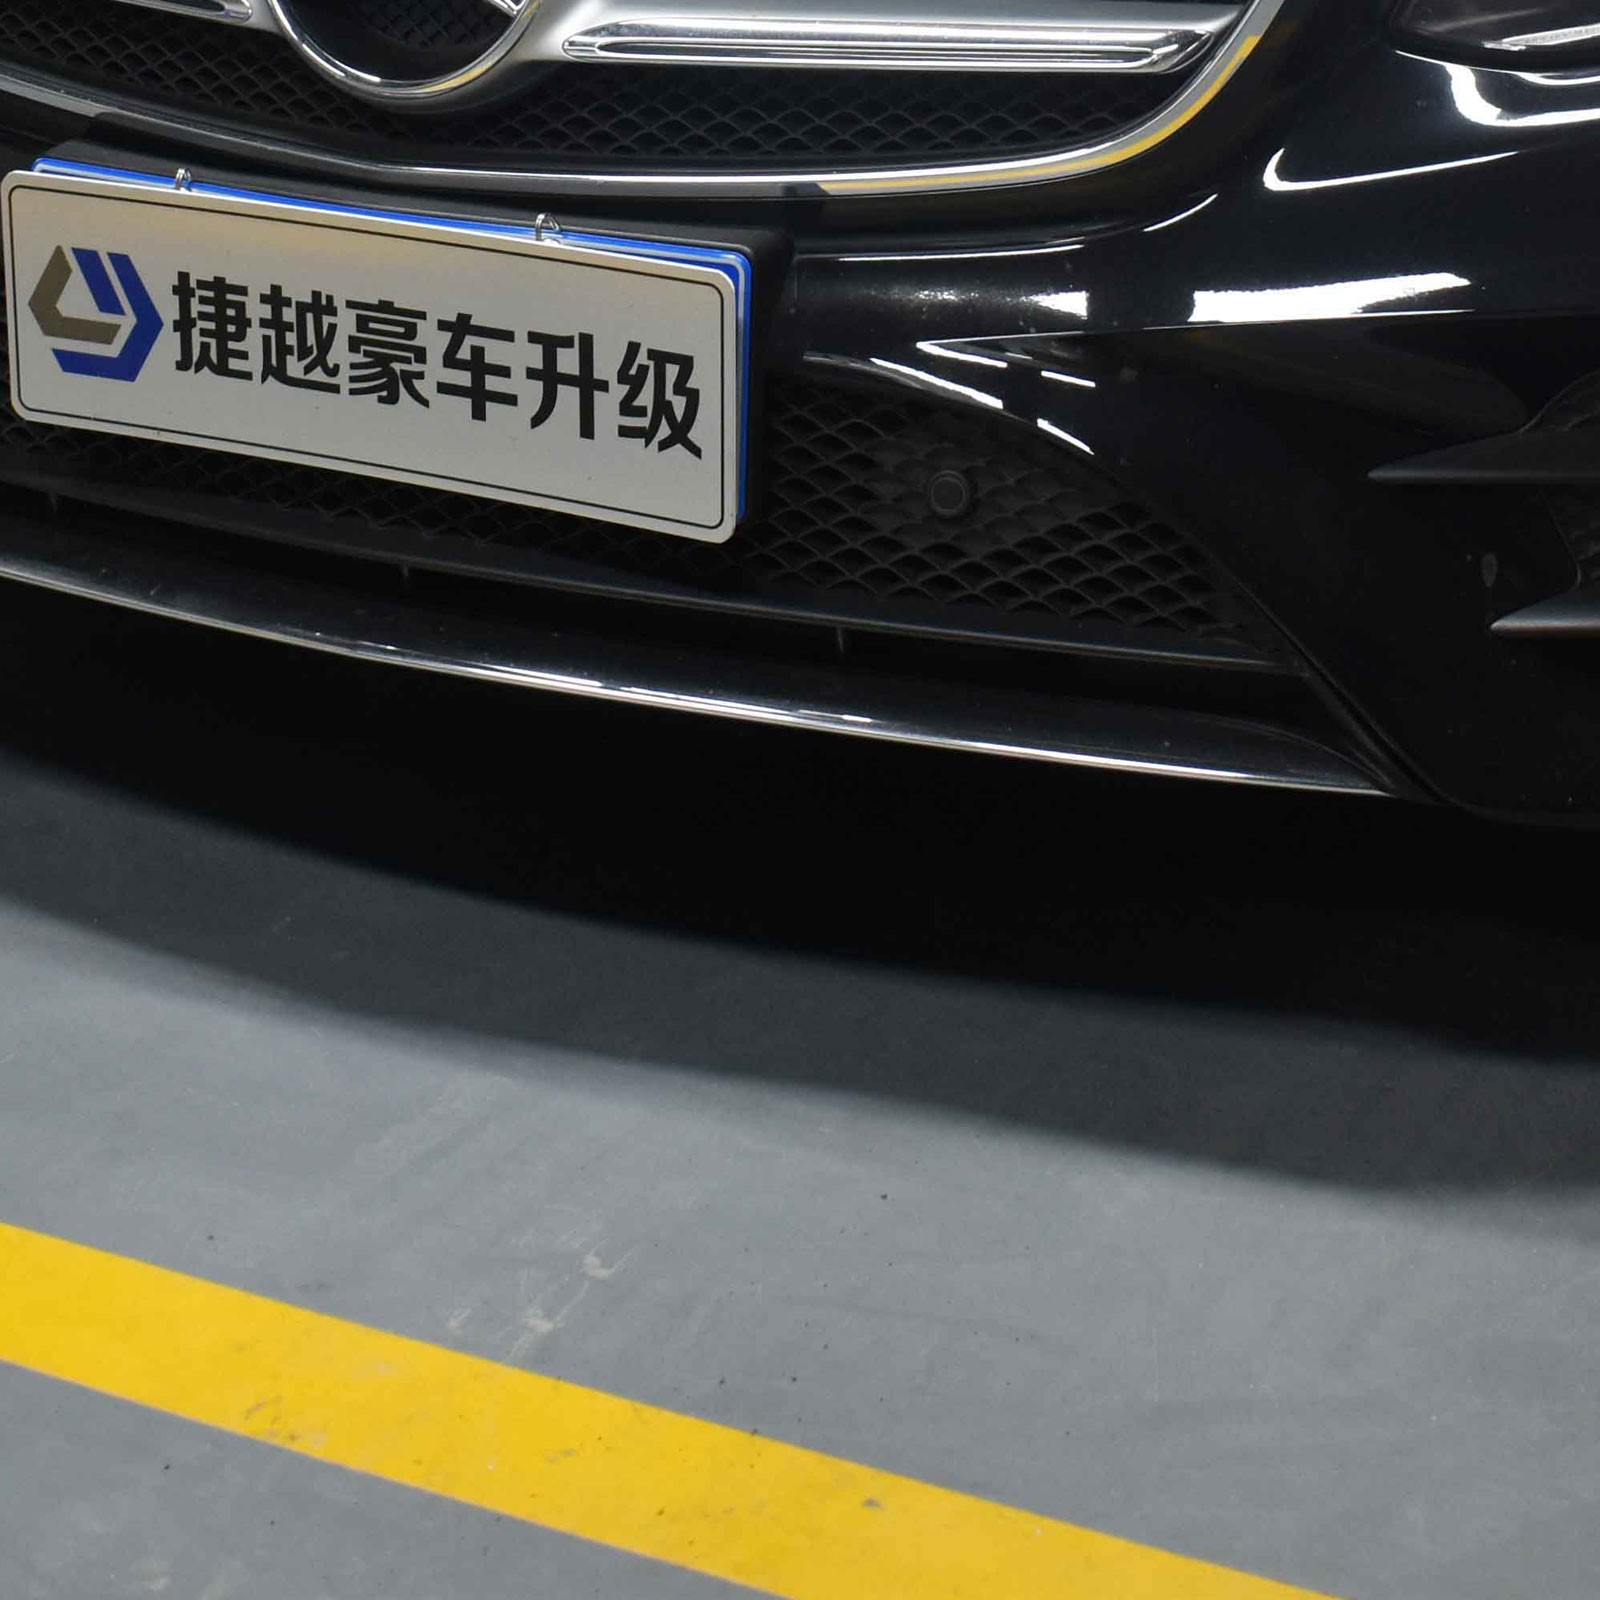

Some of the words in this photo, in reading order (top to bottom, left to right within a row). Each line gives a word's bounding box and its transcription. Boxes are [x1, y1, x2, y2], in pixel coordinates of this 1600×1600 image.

[171, 270, 702, 460] 捷越豪车升级
